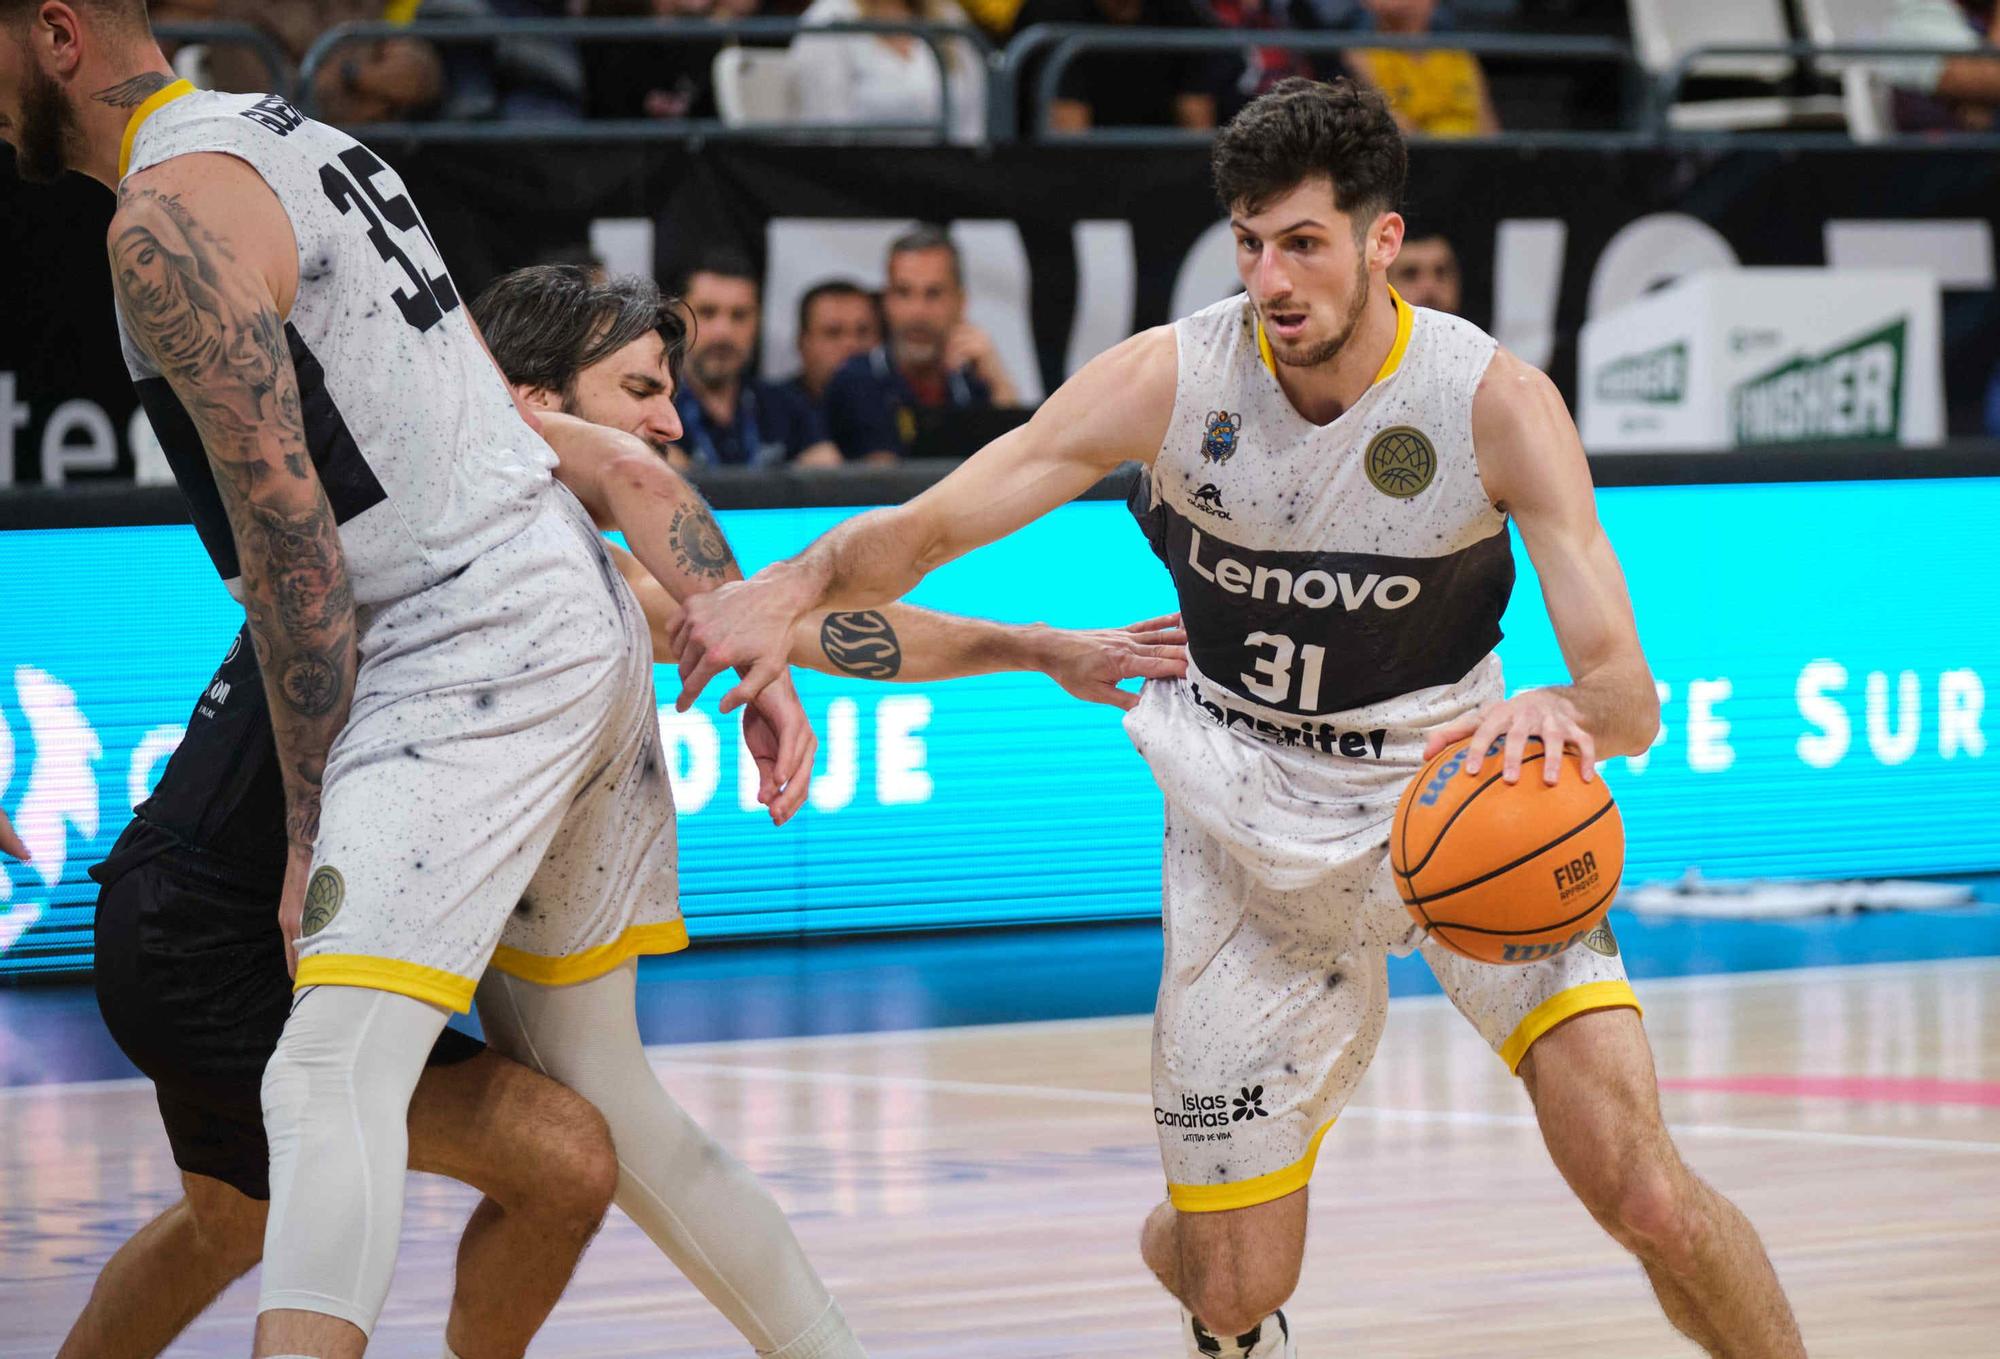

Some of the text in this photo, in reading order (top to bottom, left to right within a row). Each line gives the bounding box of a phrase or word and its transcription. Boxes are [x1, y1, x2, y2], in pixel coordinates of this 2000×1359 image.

[318, 145, 462, 334] 35
[1188, 528, 1421, 612] Lenovo
[1240, 631, 1326, 711] 31
[1553, 851, 1596, 890] FIBA
[1154, 1107, 1229, 1128] Canarias
[1182, 1093, 1227, 1111] Islas
[1182, 1133, 1205, 1143] LATITUD
[1216, 1131, 1232, 1140] VIDA
